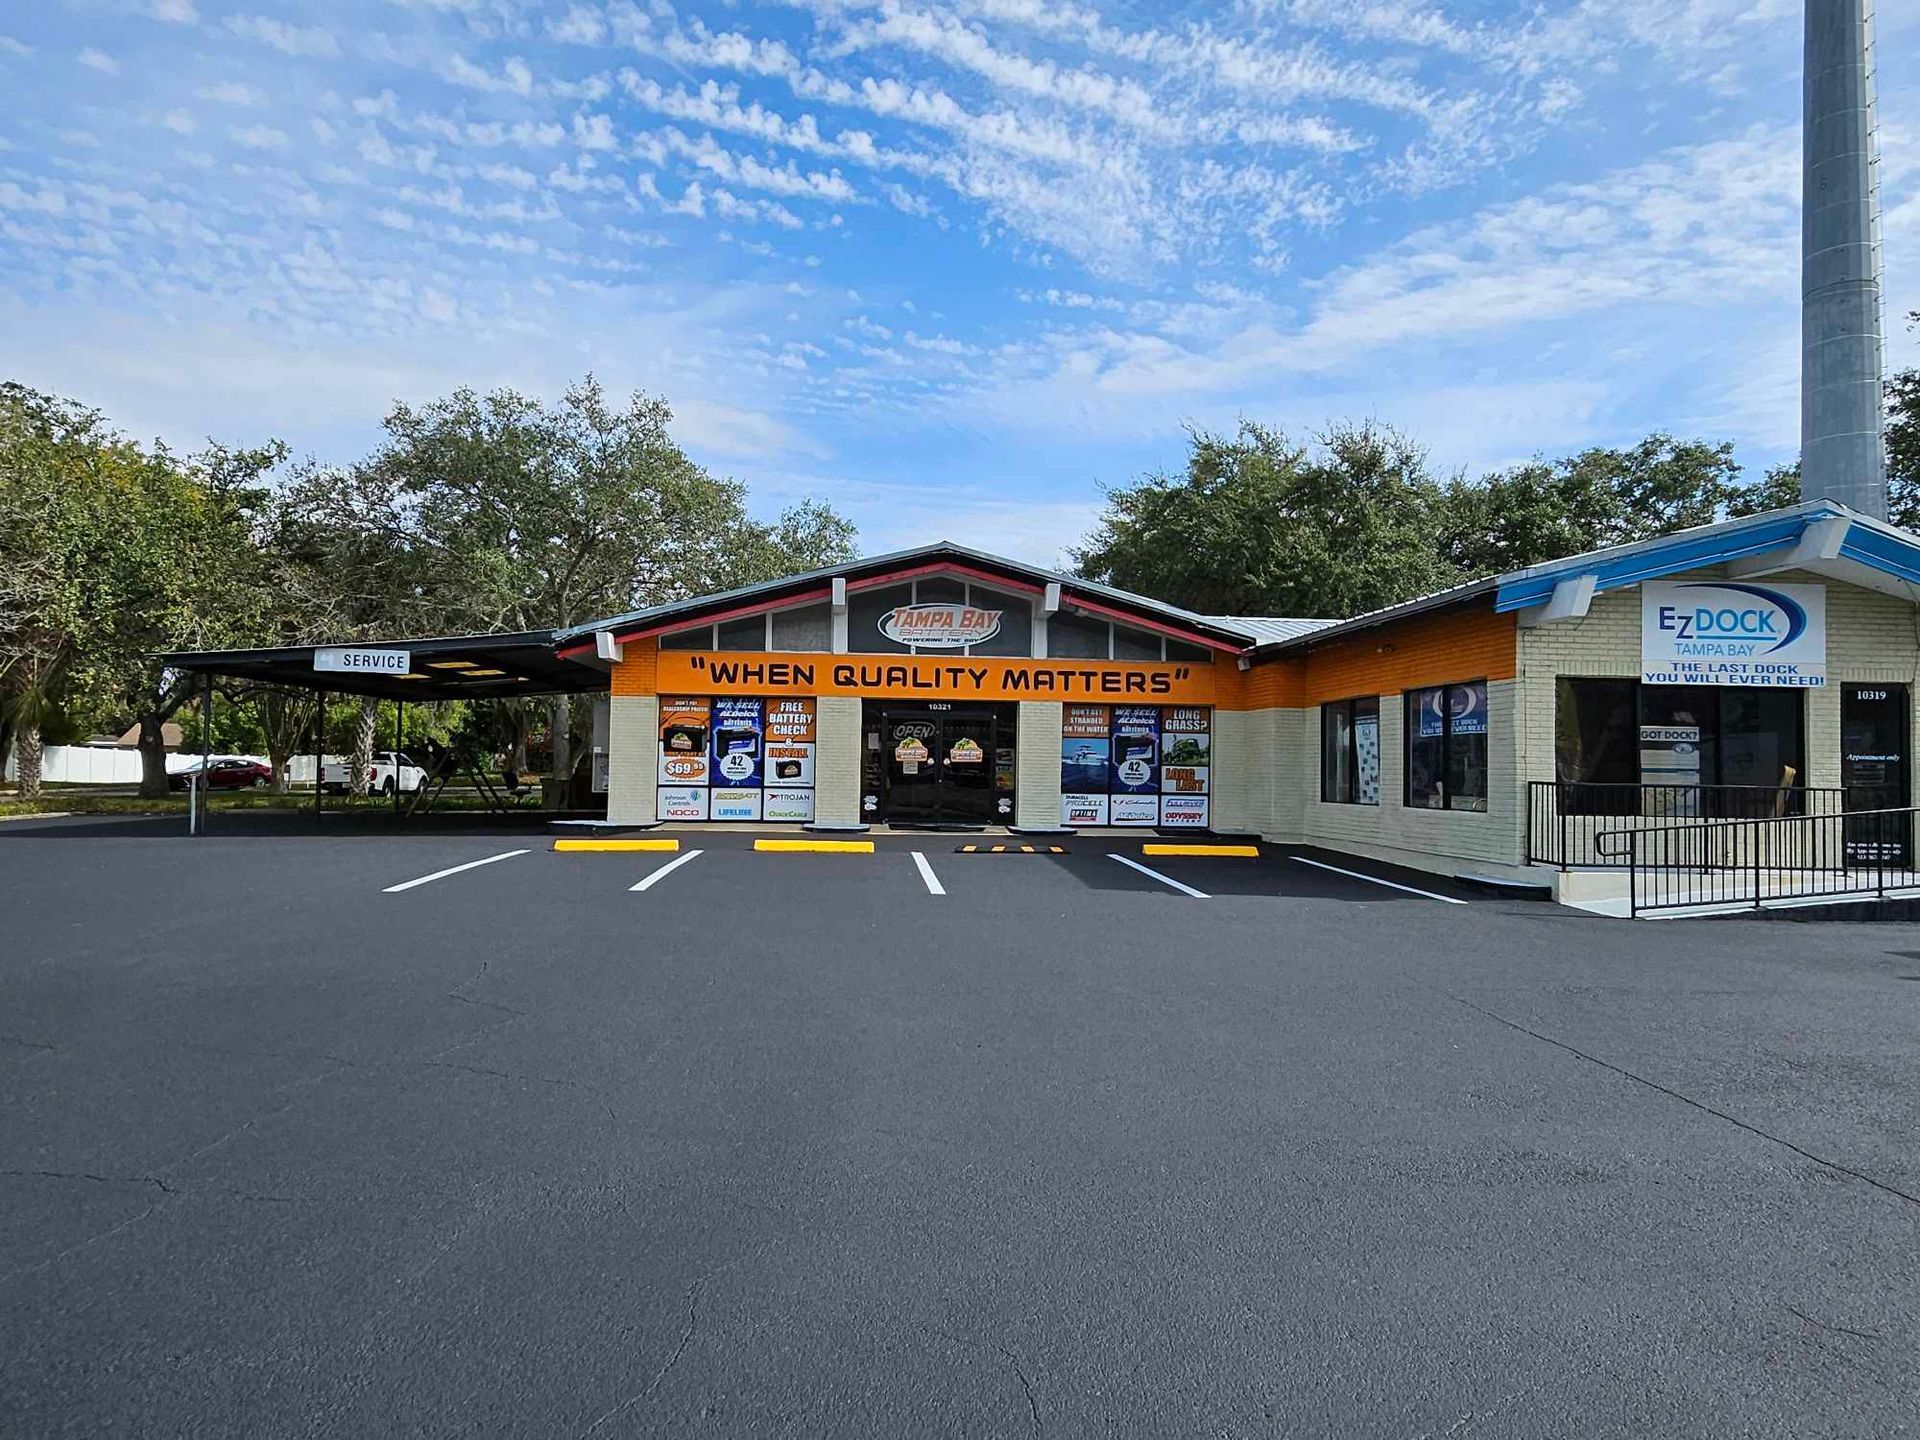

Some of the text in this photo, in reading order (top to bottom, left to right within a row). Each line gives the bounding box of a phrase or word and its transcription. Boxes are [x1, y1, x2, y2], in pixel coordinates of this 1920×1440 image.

[893, 608, 1001, 628] TAMPA BAY
[899, 628, 988, 636] BATTERY
[1674, 643, 1756, 657] TAMPA BAY
[343, 654, 404, 668] SERVICE
[1671, 663, 1798, 674] THE LAST DOCK
[833, 664, 988, 689] QUALITY
[1645, 672, 1825, 686] YOU WILL EVER NEED!
[1857, 690, 1887, 700] 10319
[736, 702, 760, 710] SELL
[780, 702, 804, 712] FREE
[769, 713, 813, 724] BATTERY
[1174, 709, 1200, 720] LONG
[773, 725, 807, 735] CHECK
[1165, 720, 1208, 731] GRASS?
[896, 725, 931, 738] OPEN
[1641, 731, 1698, 740] GOT DOCK?
[785, 738, 793, 747] &
[768, 748, 808, 758] INSTALL
[1846, 753, 1900, 761] Appointment only
[730, 755, 743, 767] 42
[1128, 762, 1140, 772] 42
[1165, 768, 1195, 780] LONG
